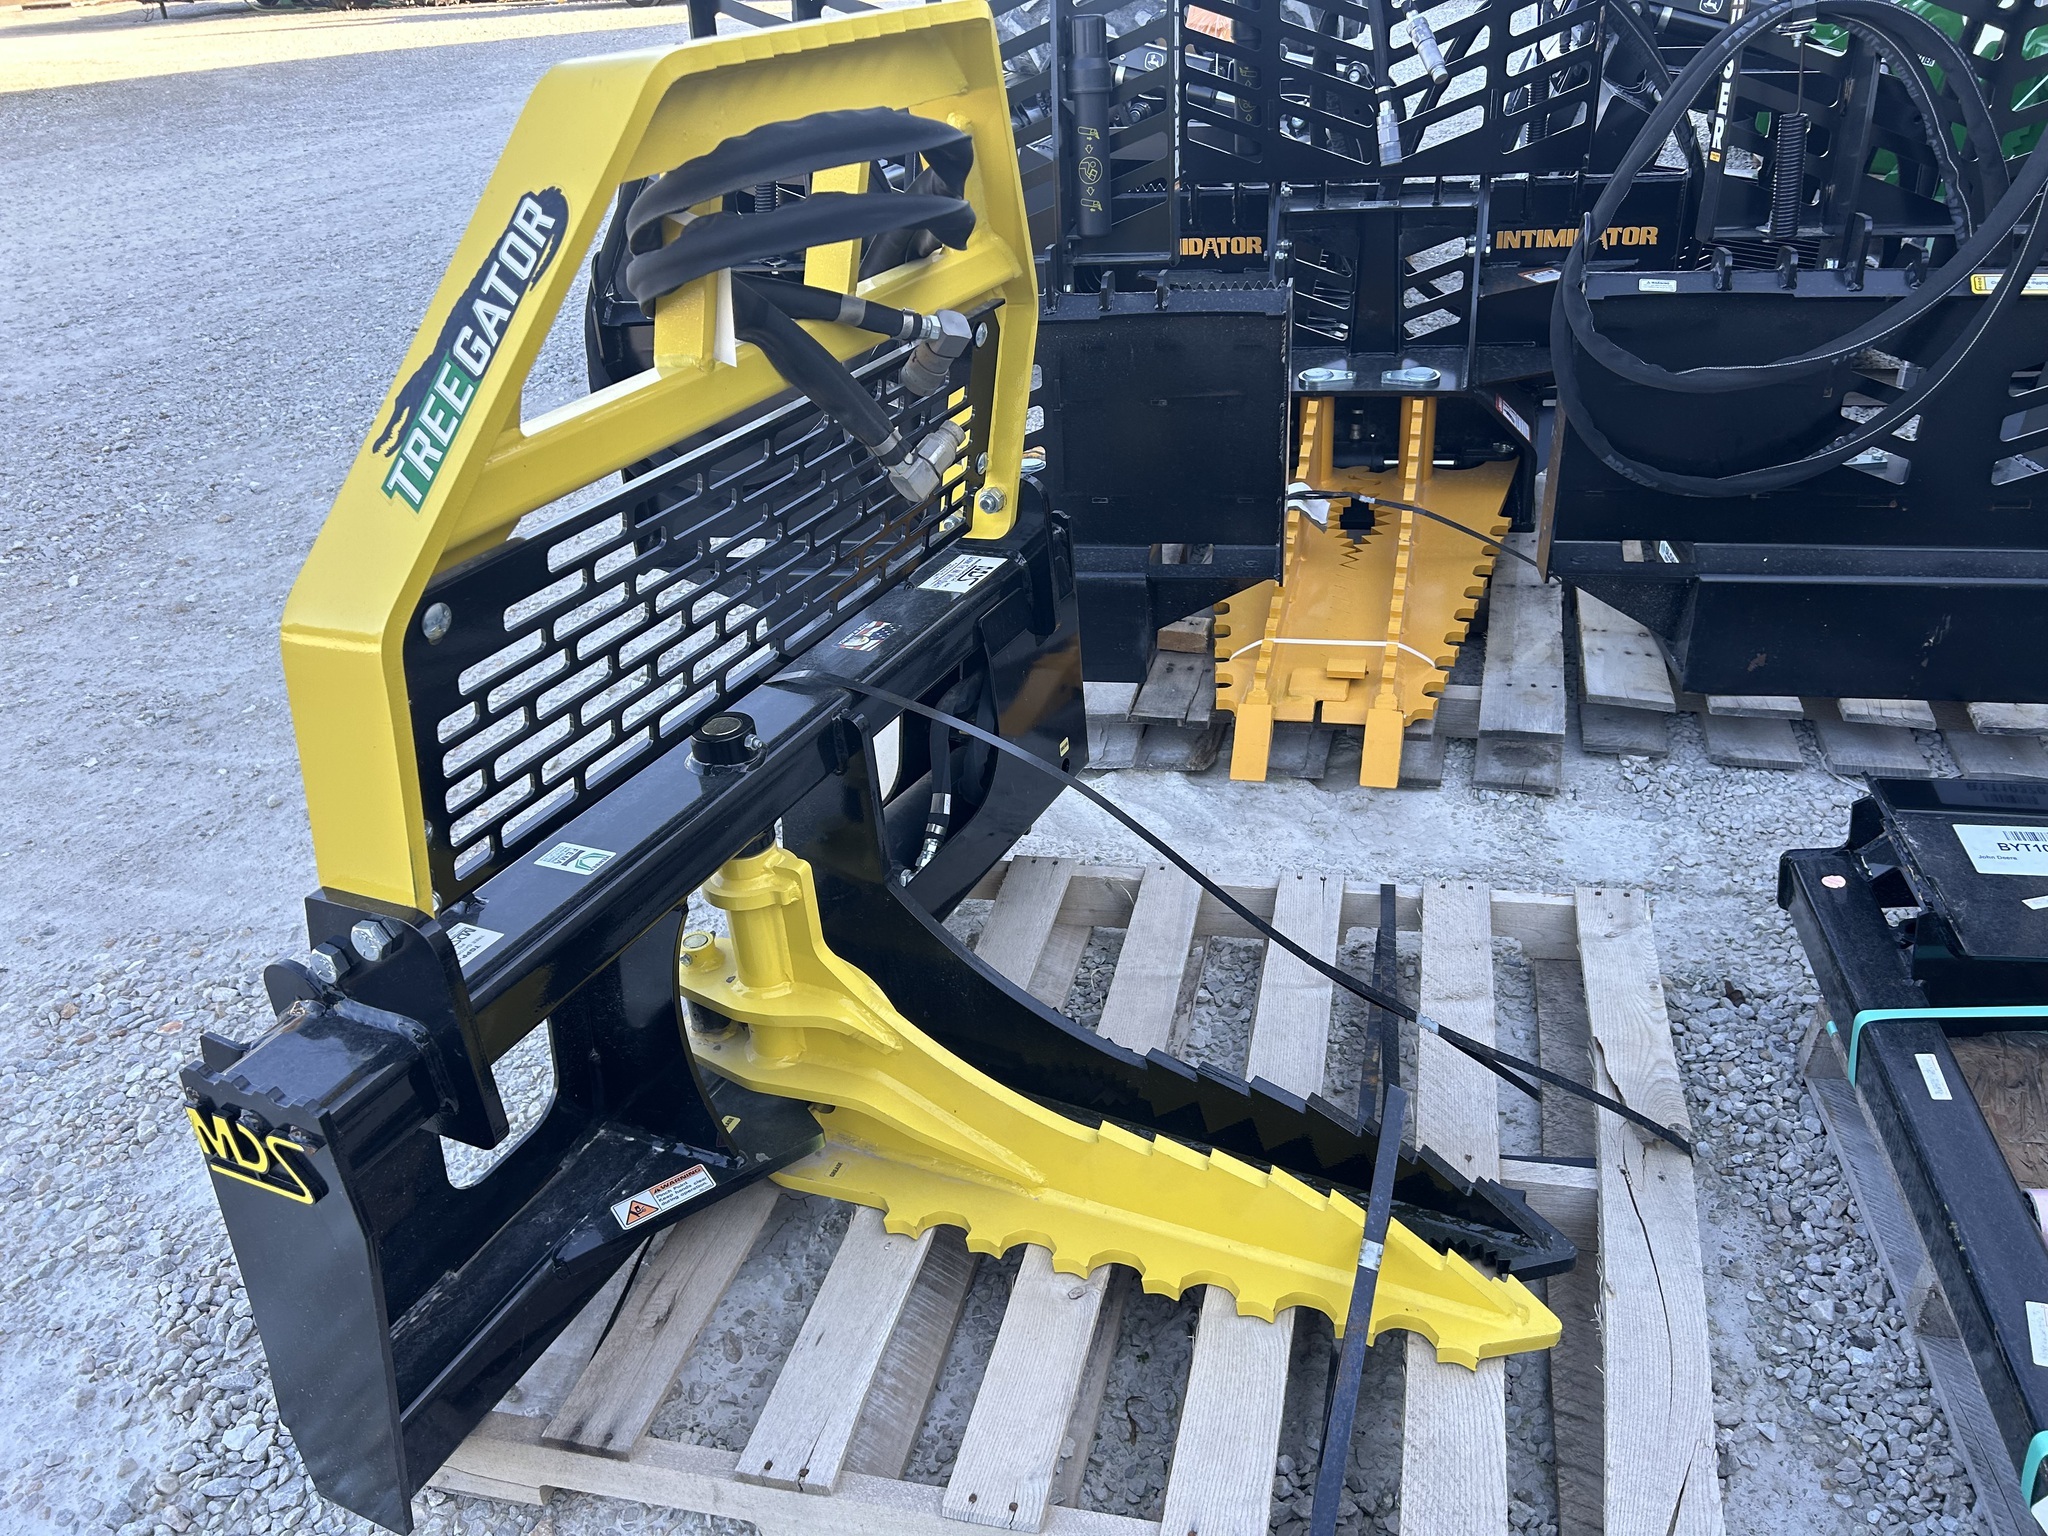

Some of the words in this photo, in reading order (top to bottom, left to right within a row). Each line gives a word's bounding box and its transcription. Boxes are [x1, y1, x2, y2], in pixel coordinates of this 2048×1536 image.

[1180, 236, 1262, 259] IDATOR
[1496, 226, 1658, 250] INTIMITOR
[387, 362, 475, 505] TREE
[453, 197, 556, 377] GATOR
[186, 1106, 316, 1205] MDS
[660, 1168, 701, 1189] WARNING
[658, 1193, 674, 1202] Keep
[675, 1184, 692, 1194] hands
[661, 1195, 679, 1206] during
